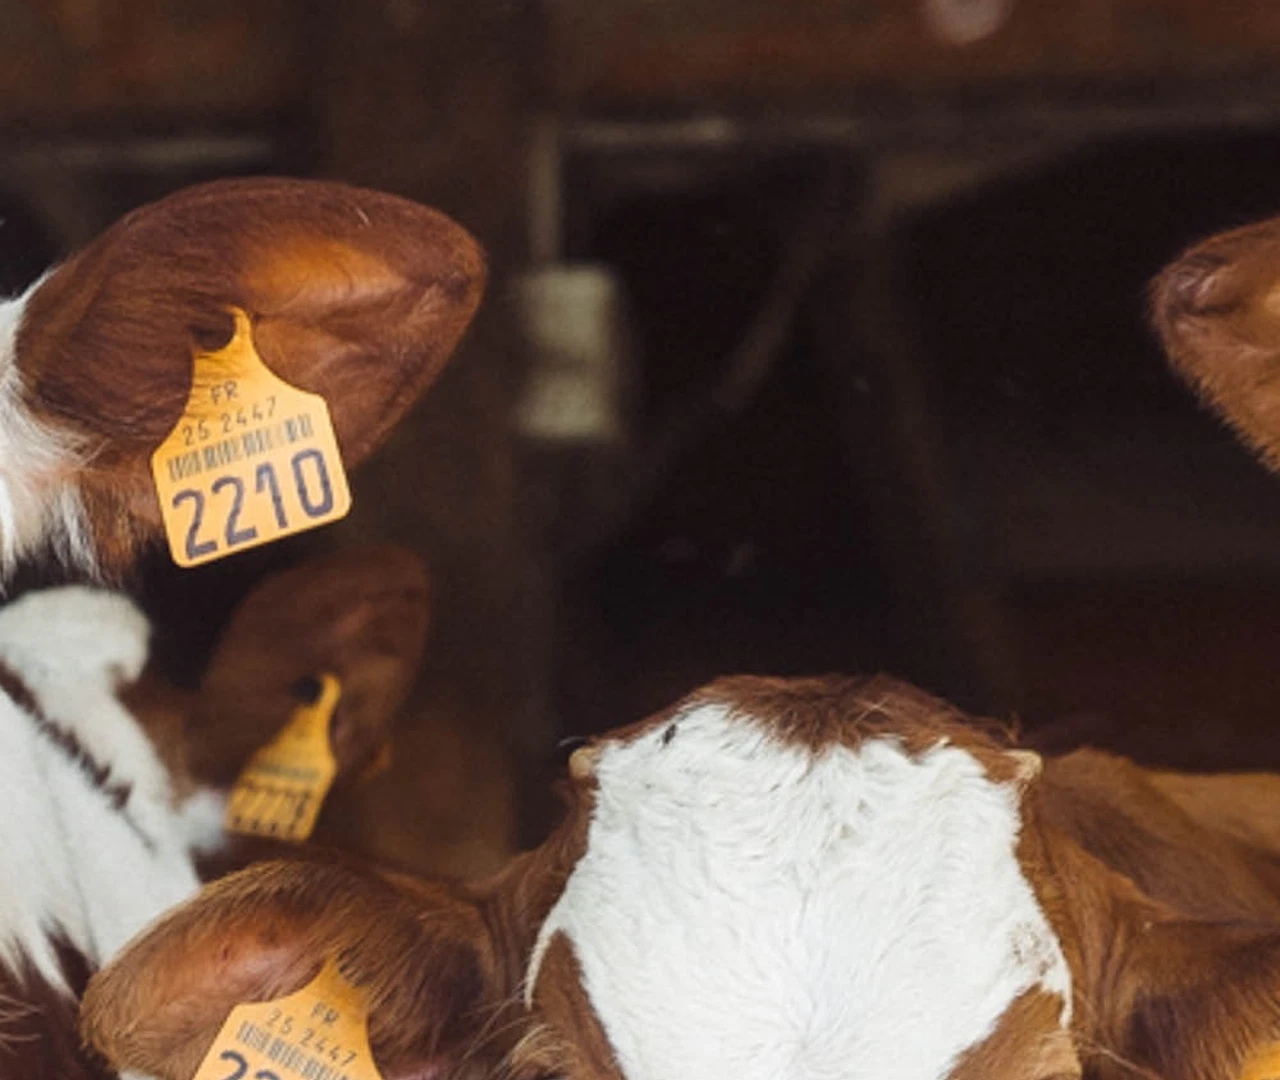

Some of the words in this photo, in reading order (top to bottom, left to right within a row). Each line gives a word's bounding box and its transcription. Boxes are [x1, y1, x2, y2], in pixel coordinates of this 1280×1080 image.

[210, 380, 237, 404] FR
[182, 419, 211, 446] 25
[221, 395, 276, 433] 2447
[172, 448, 334, 560] 2210
